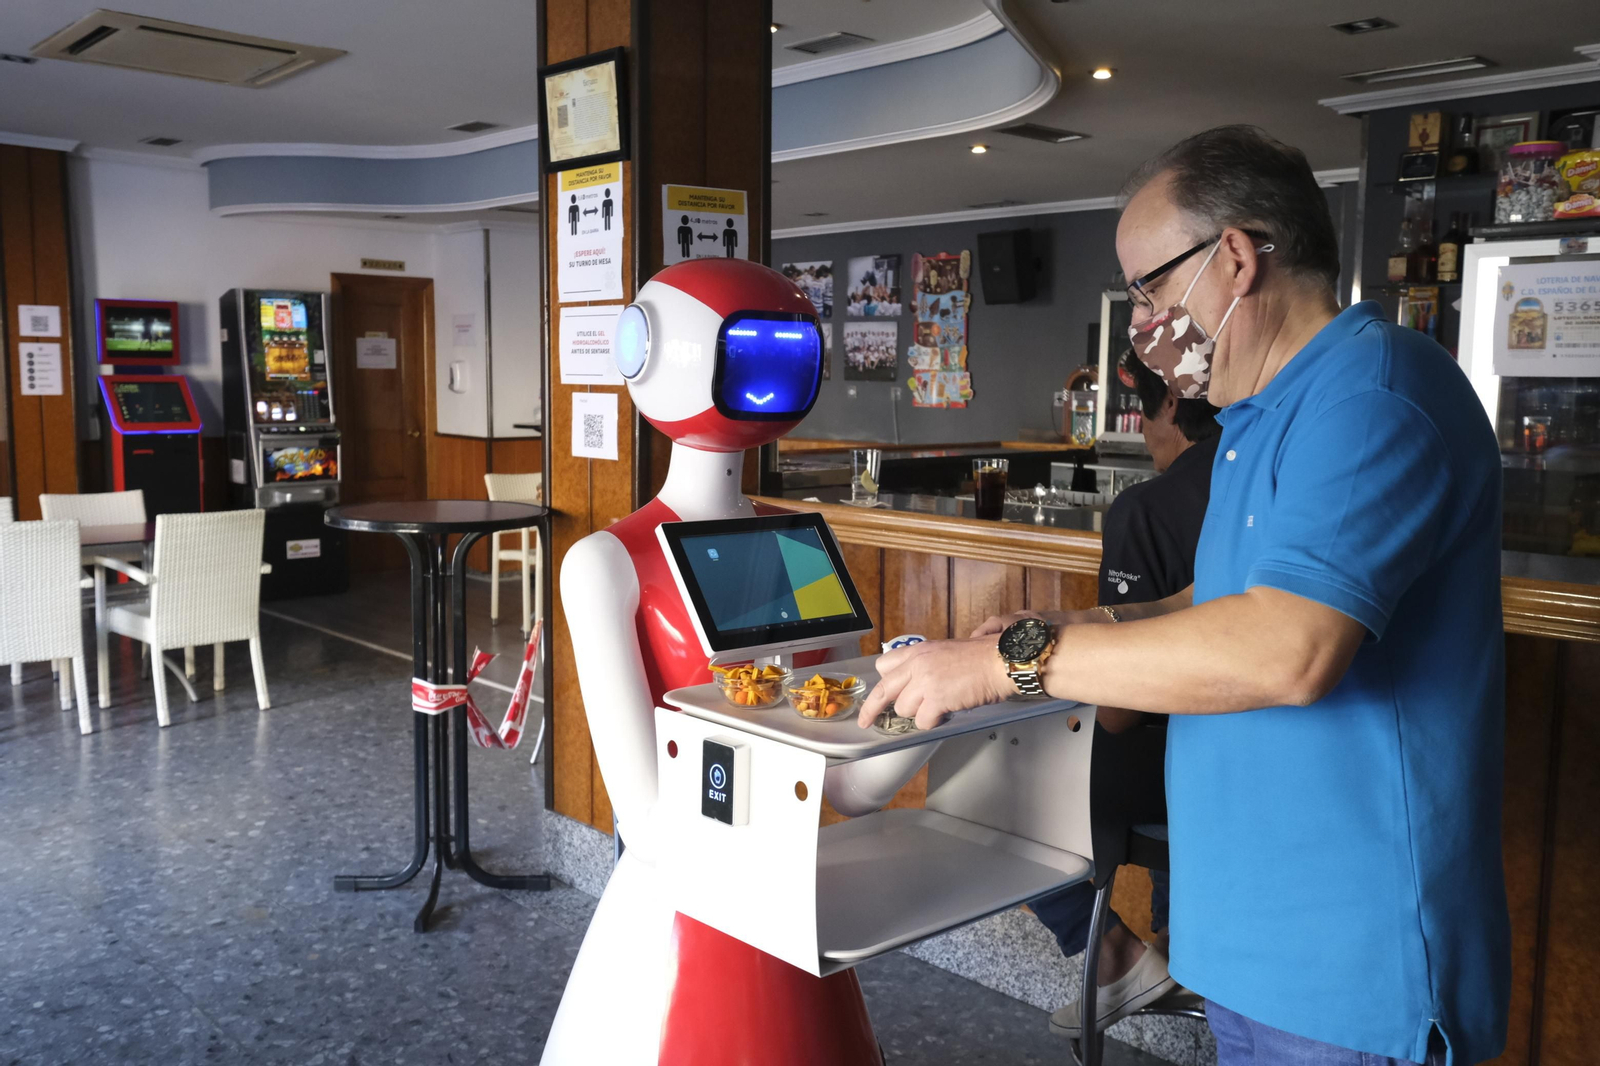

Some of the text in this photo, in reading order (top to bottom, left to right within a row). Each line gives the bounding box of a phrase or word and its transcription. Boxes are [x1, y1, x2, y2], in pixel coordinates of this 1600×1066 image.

[576, 169, 597, 178] MANTENGA
[1567, 162, 1597, 177] Damel
[568, 178, 589, 186] DISTANCIA
[1564, 198, 1592, 211] Damel
[1536, 276, 1569, 284] LOTERIA
[1538, 286, 1573, 295] ESPAÑOL
[709, 789, 726, 802] EXIT
